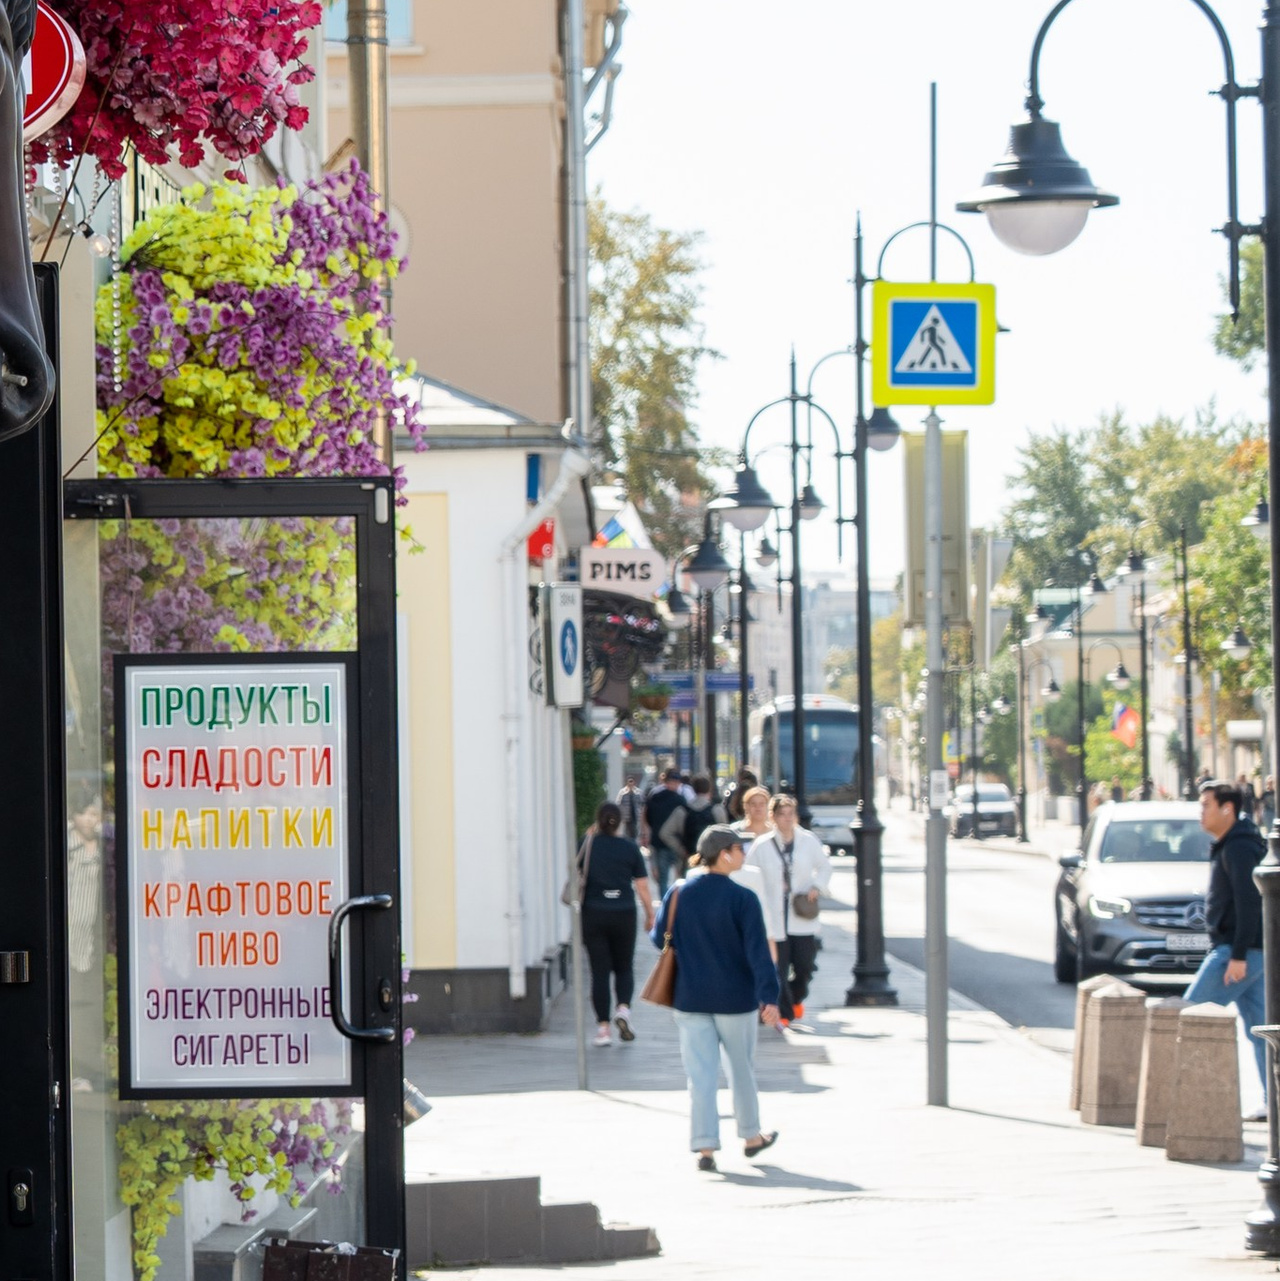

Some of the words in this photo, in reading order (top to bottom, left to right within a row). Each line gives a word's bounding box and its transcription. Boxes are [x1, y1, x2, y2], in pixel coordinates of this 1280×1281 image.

[590, 561, 651, 580] PIMS
[141, 685, 330, 730] ПРОДУКТЫ
[142, 747, 332, 793] СЛАДОСТИ
[142, 807, 333, 849] НАПИТКИ
[144, 880, 332, 917] КРАФТОВОЕ
[198, 930, 279, 966] ПИВО
[146, 986, 333, 1020] ЭЛЕКТРОННЫЕ
[173, 1032, 309, 1066] СИГАРЕТЫ
